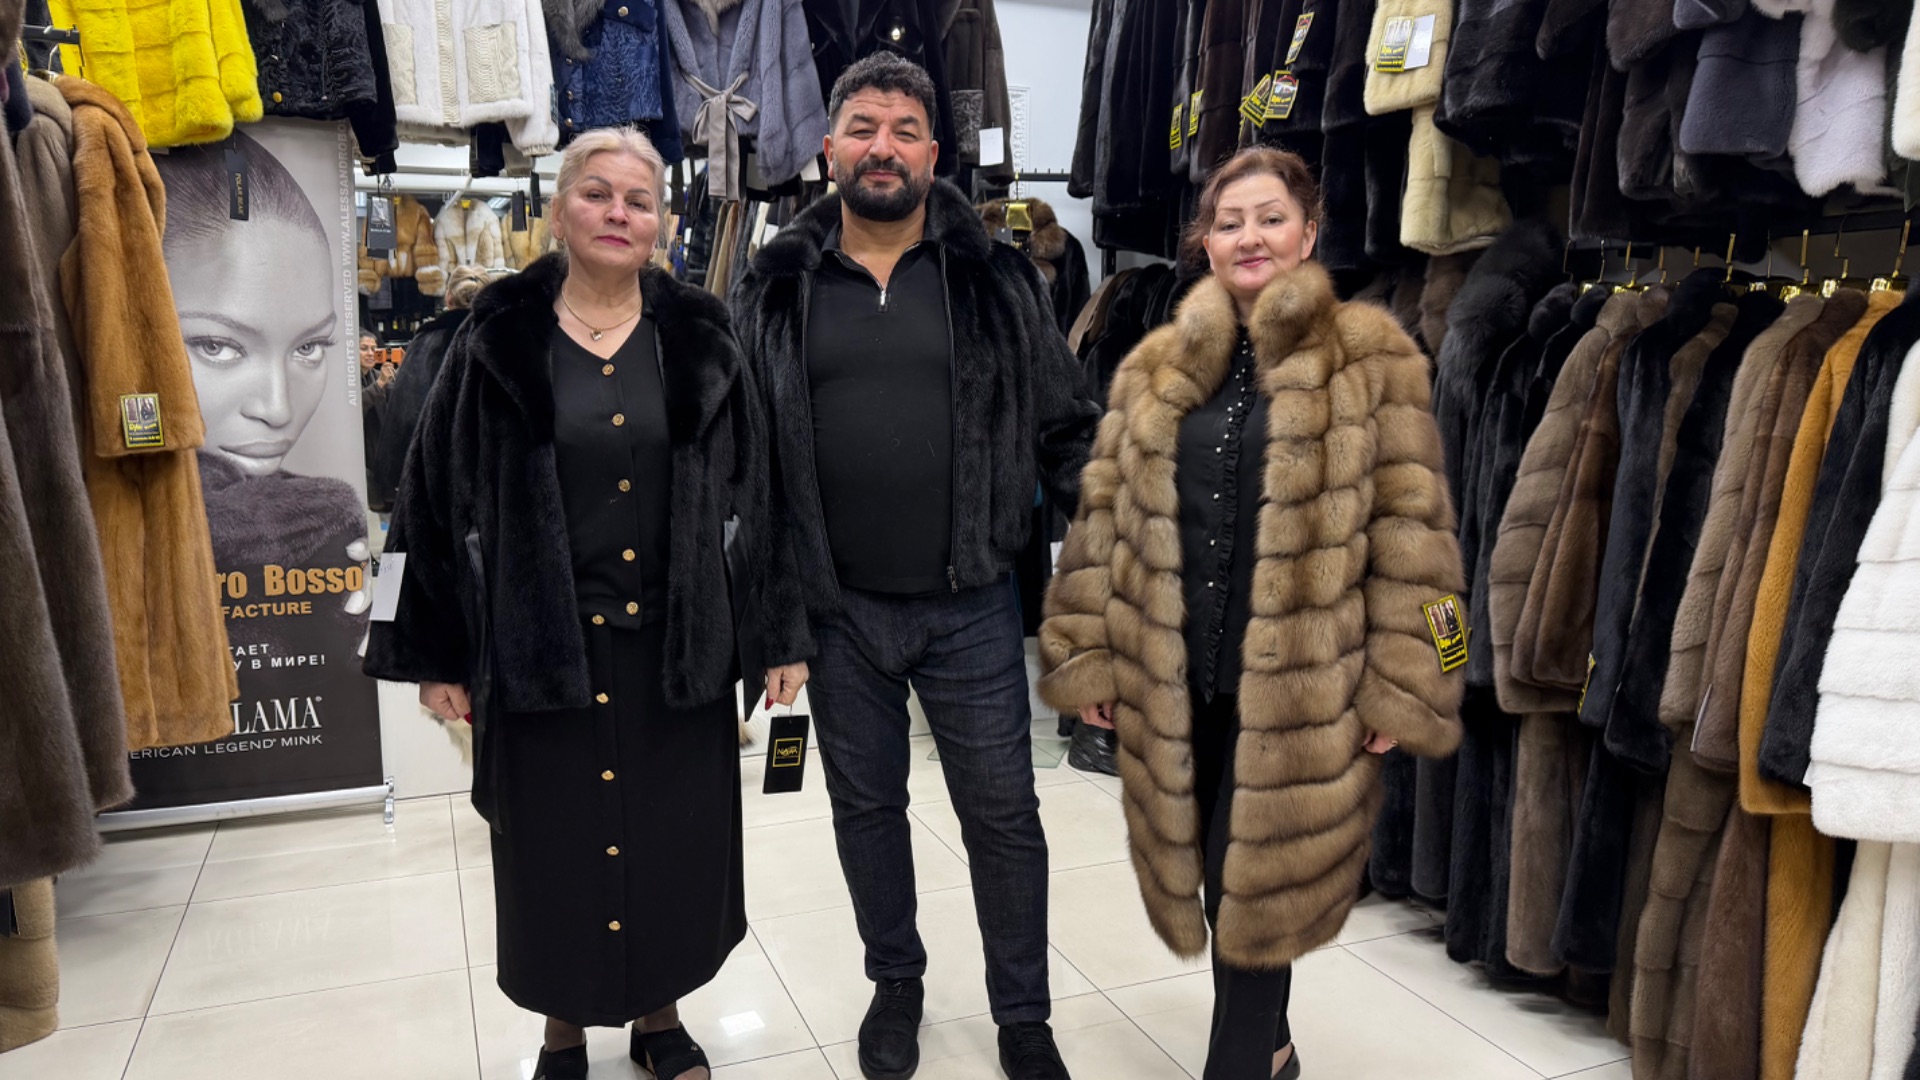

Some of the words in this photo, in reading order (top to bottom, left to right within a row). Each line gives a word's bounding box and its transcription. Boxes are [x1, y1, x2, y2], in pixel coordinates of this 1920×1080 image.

[343, 269, 354, 336] RESERVED
[347, 340, 357, 387] RIGHTS
[252, 659, 262, 670] В
[271, 654, 325, 668] МИРЕ!
[281, 734, 322, 748] MINK
